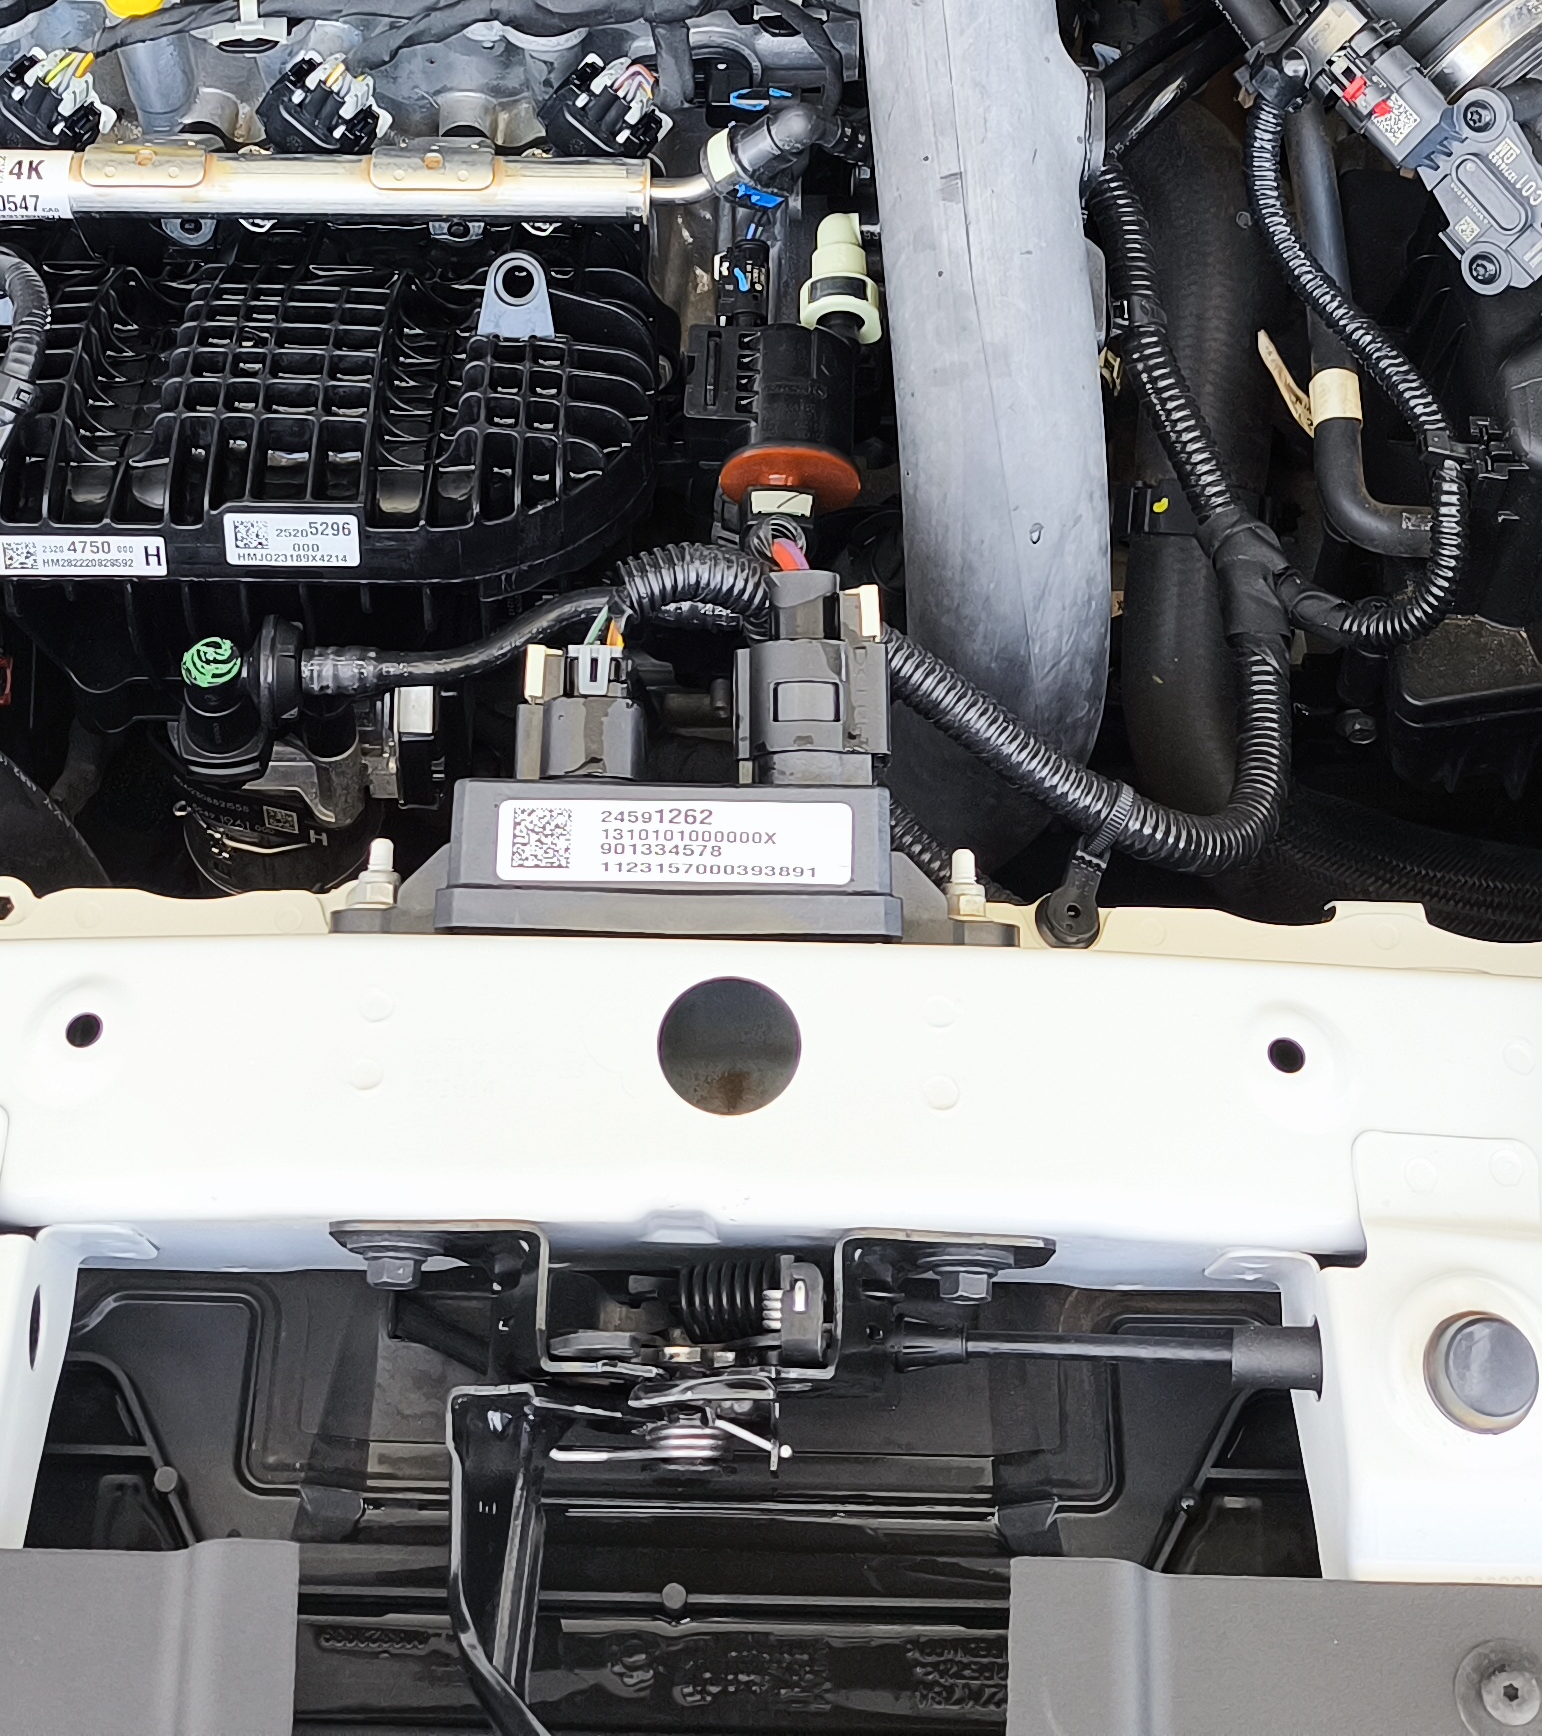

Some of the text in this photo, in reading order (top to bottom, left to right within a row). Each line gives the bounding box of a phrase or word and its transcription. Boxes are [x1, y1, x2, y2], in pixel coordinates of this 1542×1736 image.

[9, 160, 45, 180] 4K
[293, 543, 319, 552] 000
[144, 546, 162, 566] H
[600, 808, 713, 825] 24591262
[310, 830, 328, 846] H
[600, 842, 723, 857] 901334578
[602, 862, 817, 878] 1123157000393891
